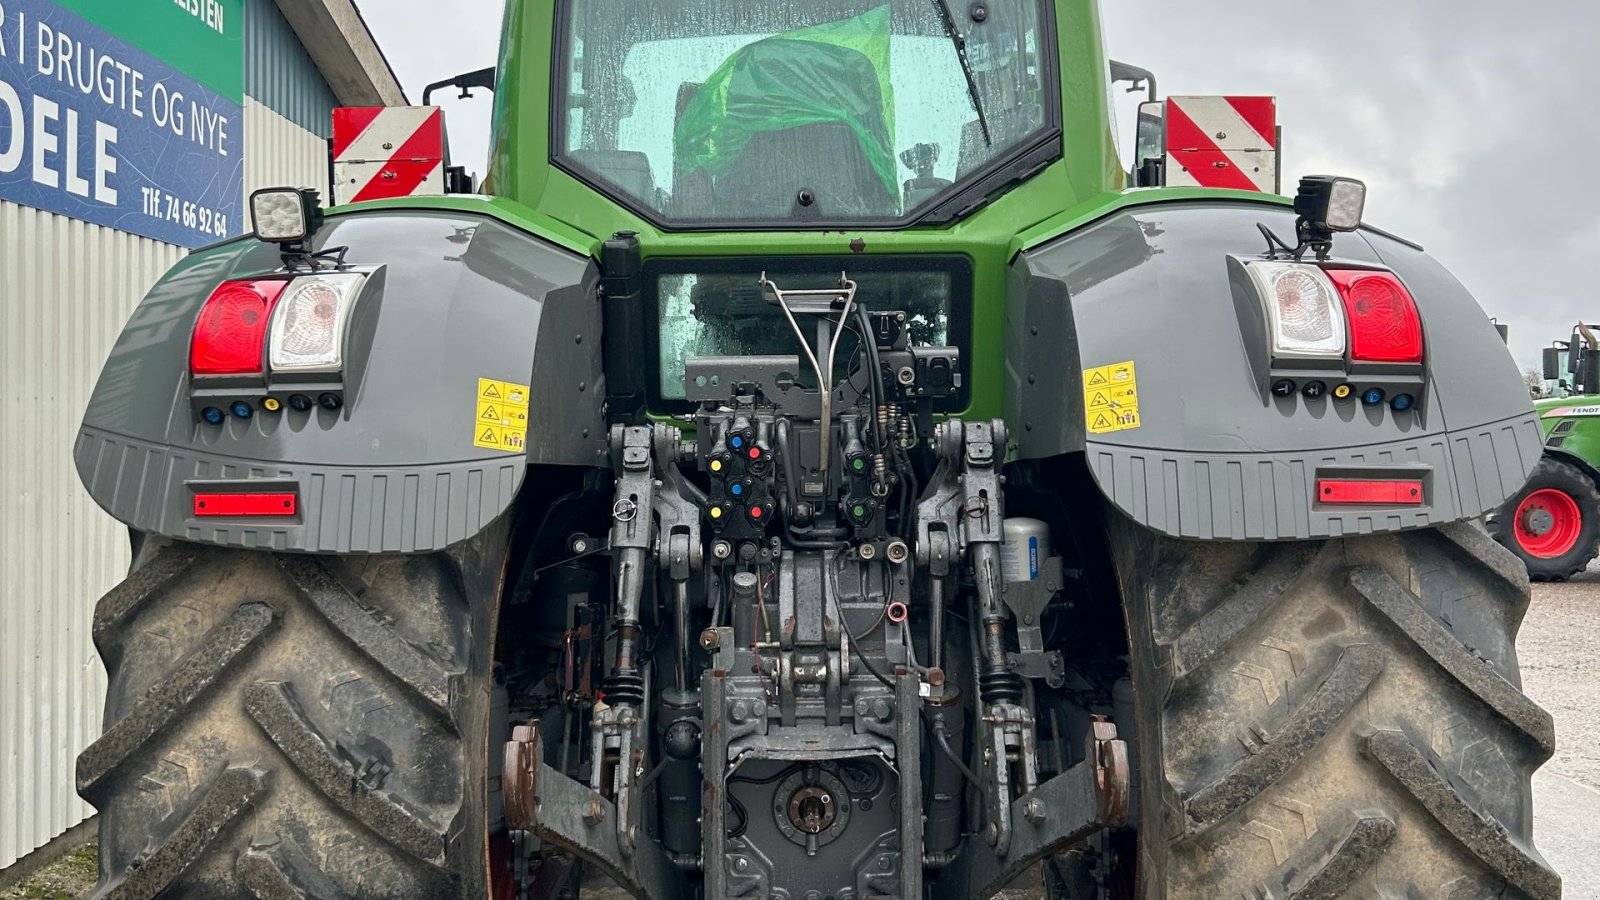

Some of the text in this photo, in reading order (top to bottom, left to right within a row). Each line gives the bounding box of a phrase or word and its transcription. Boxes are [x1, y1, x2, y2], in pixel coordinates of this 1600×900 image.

[19, 11, 25, 65] I
[38, 21, 144, 118] BRUGTE
[151, 82, 184, 136] OG
[191, 100, 228, 157] NYE
[141, 186, 227, 239] Tlf. 74 66 92 64
